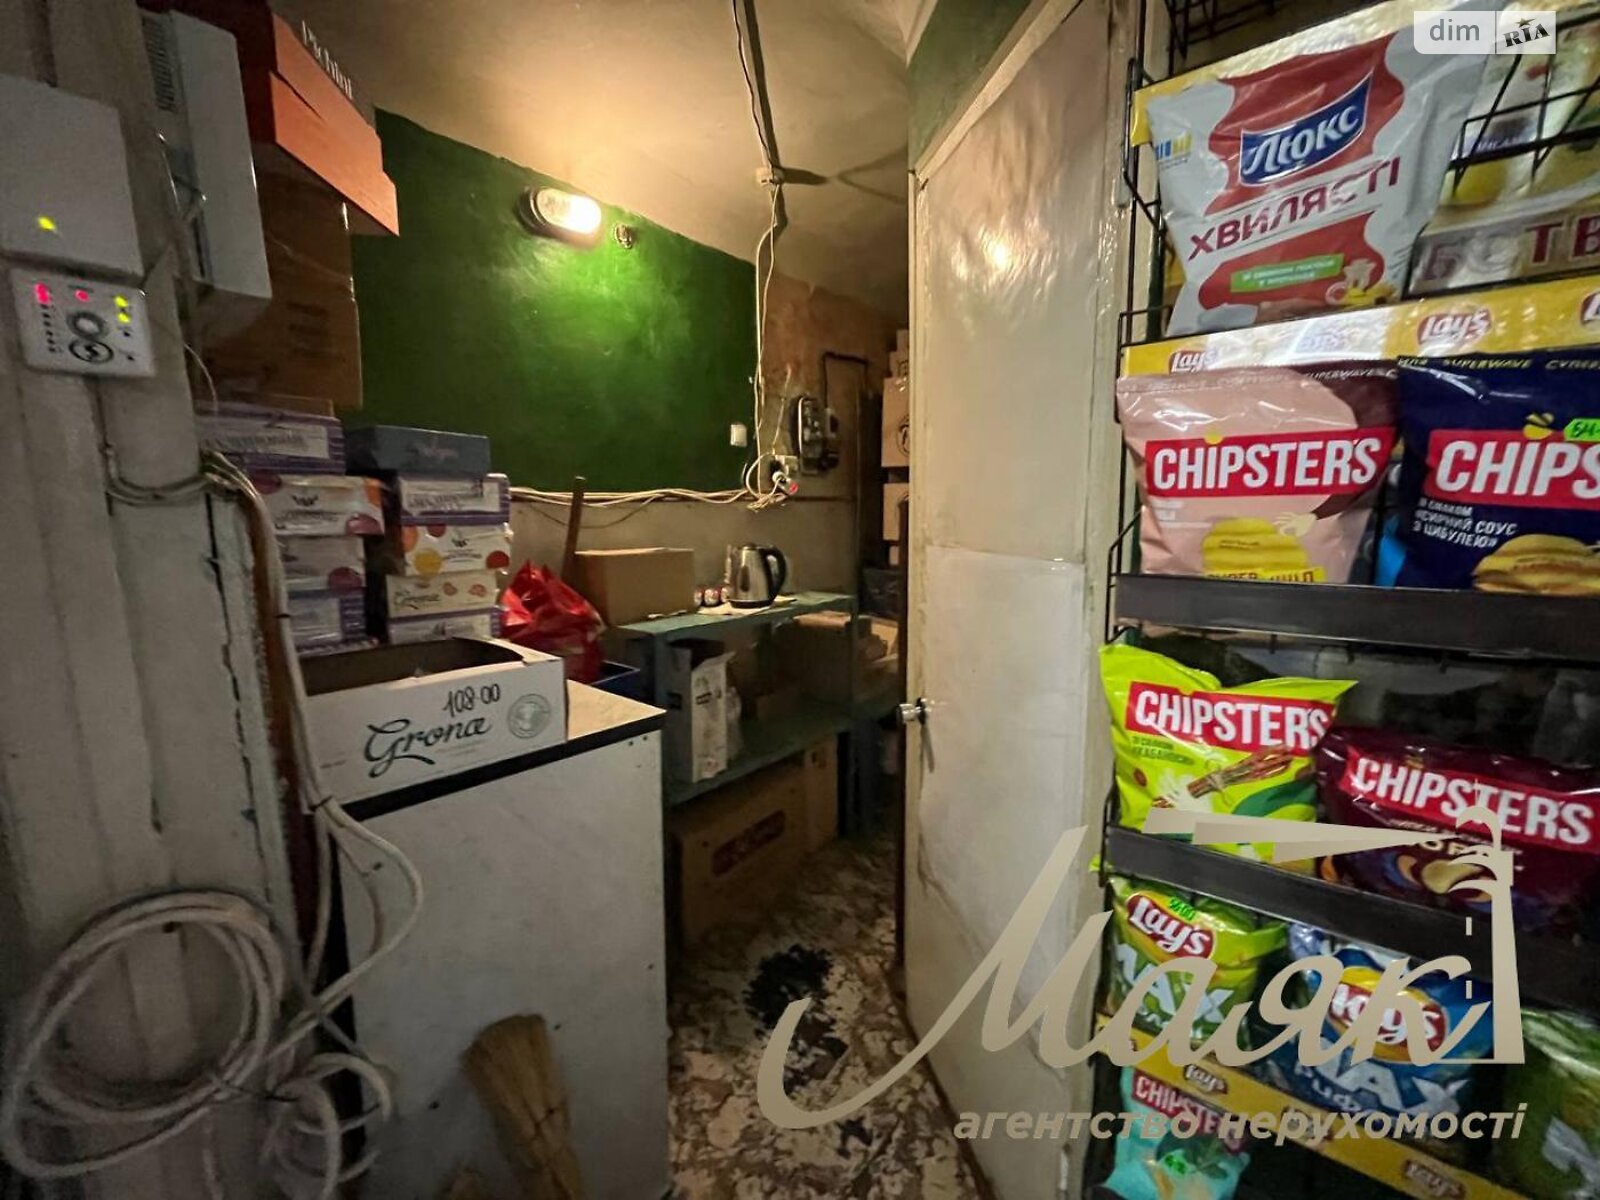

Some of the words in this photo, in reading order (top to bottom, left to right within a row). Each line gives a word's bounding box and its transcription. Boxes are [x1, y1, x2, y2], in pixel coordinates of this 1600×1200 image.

[1243, 105, 1359, 175] Люкс
[1188, 157, 1400, 262] ХВИЛЯСТІ
[1475, 521, 1518, 536] СОУС
[364, 718, 493, 778] Grona
[1130, 897, 1210, 954] Lay's
